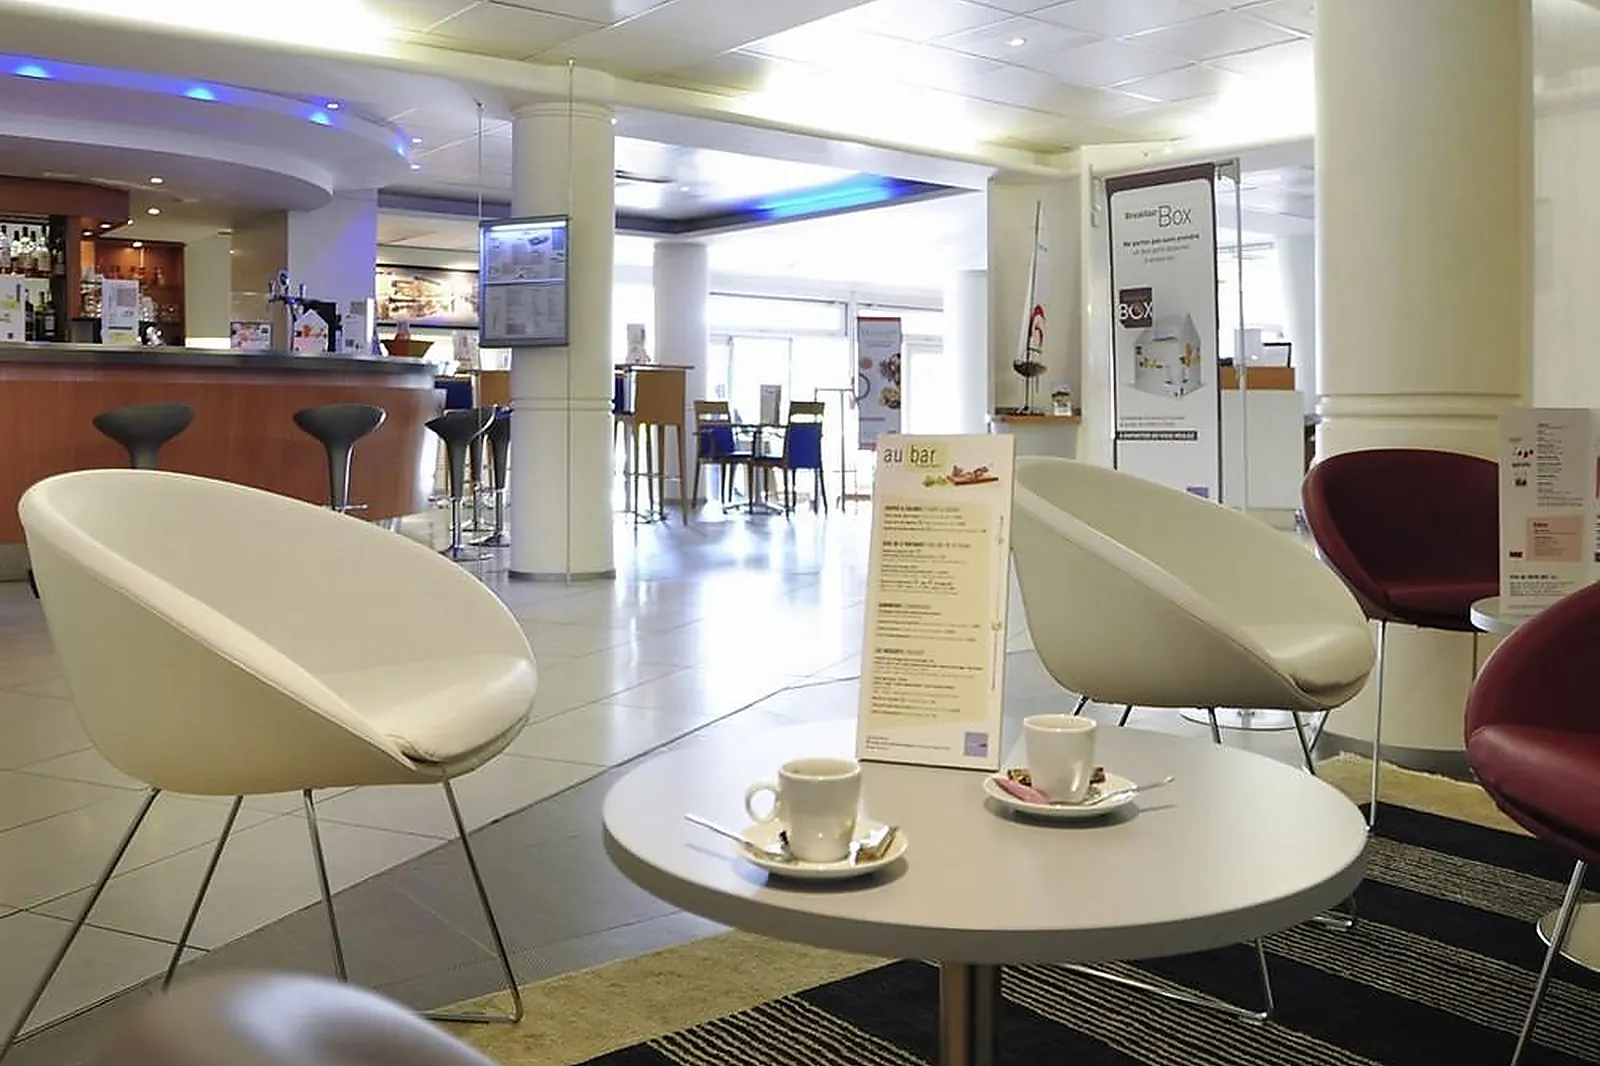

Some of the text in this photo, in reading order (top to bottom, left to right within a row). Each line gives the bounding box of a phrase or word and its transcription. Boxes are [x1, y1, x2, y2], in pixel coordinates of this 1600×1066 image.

[1158, 205, 1192, 228] Box
[1117, 302, 1153, 320] BOX
[883, 444, 936, 463] au bar
